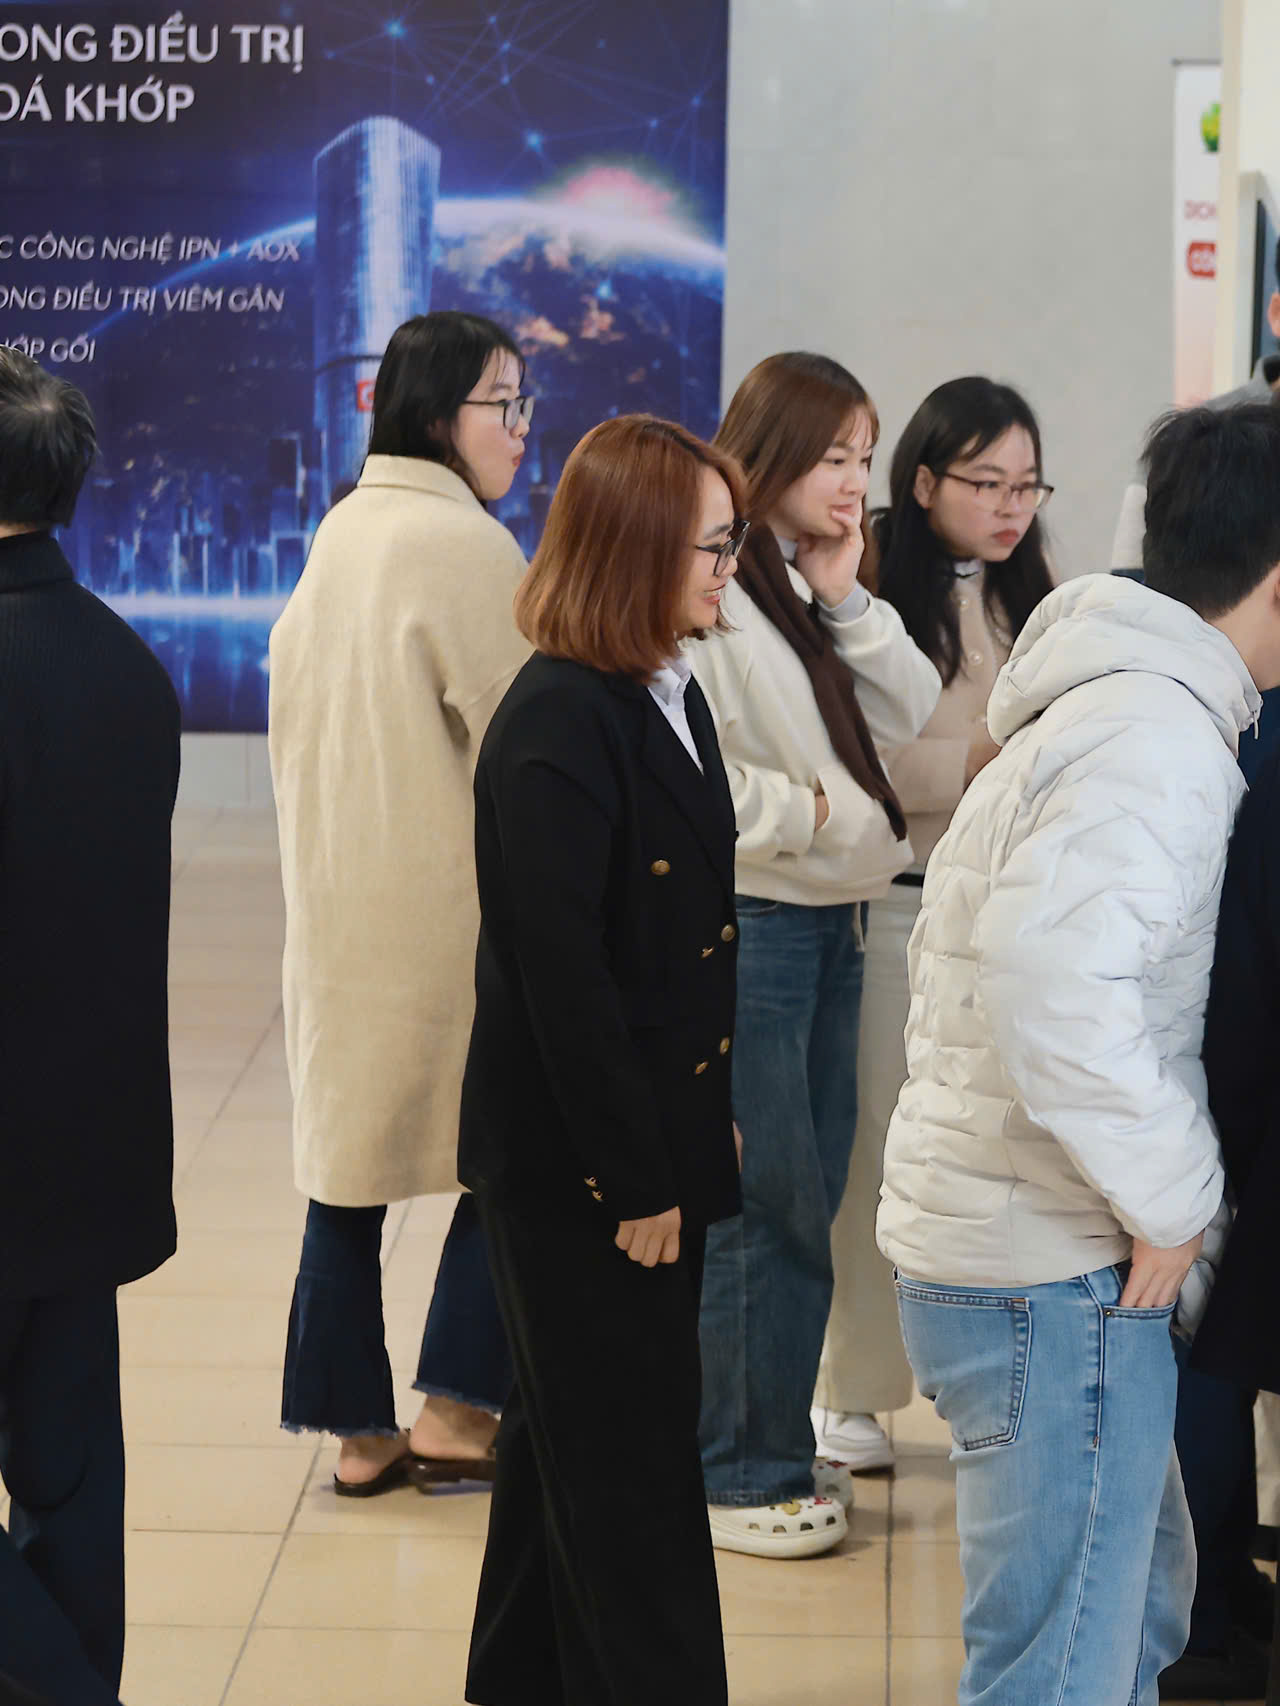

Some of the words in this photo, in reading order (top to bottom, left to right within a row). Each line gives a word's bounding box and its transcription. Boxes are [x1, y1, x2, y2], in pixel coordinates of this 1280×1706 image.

[110, 10, 219, 63] ĐIỀU
[230, 24, 304, 74] TRỊ
[65, 73, 195, 122] KHỚP
[20, 230, 95, 260] CÔNG
[101, 231, 173, 265] NGHỆ
[179, 235, 221, 260] IPN
[53, 280, 112, 311] ĐIỀU
[119, 286, 157, 316] TRỊ
[163, 283, 224, 312] VIÊM
[50, 333, 96, 363] GỐI
